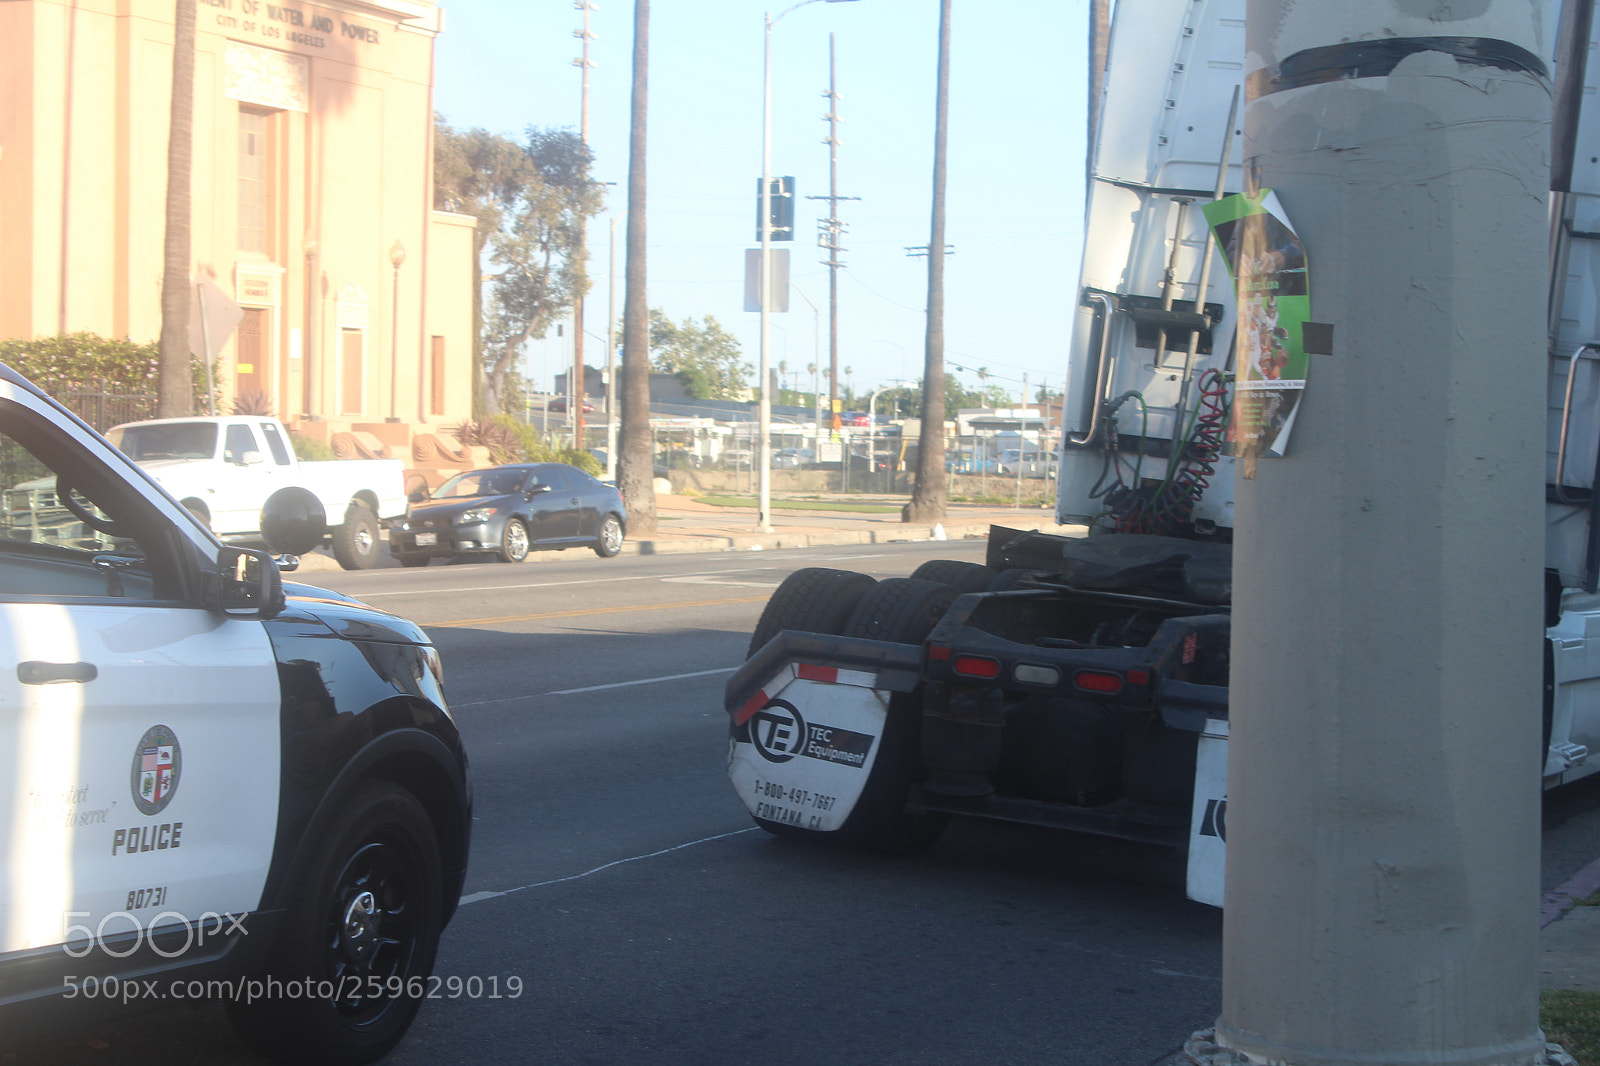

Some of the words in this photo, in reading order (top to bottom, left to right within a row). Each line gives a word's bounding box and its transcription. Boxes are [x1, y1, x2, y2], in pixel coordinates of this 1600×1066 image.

[216, 14, 238, 29] CITY
[242, 20, 257, 33] OF
[261, 24, 281, 39] LOS
[286, 30, 325, 48] ANGELES
[242, 0, 260, 16] OF
[266, 4, 304, 27] WATER
[310, 14, 334, 34] AND
[341, 20, 379, 45] POWER
[810, 726, 834, 743] TEC
[808, 741, 865, 765] Equipment
[754, 779, 836, 812] 1-800-497-7667
[808, 815, 823, 830] CA
[112, 822, 183, 856] POLICE
[126, 886, 168, 911] 80731
